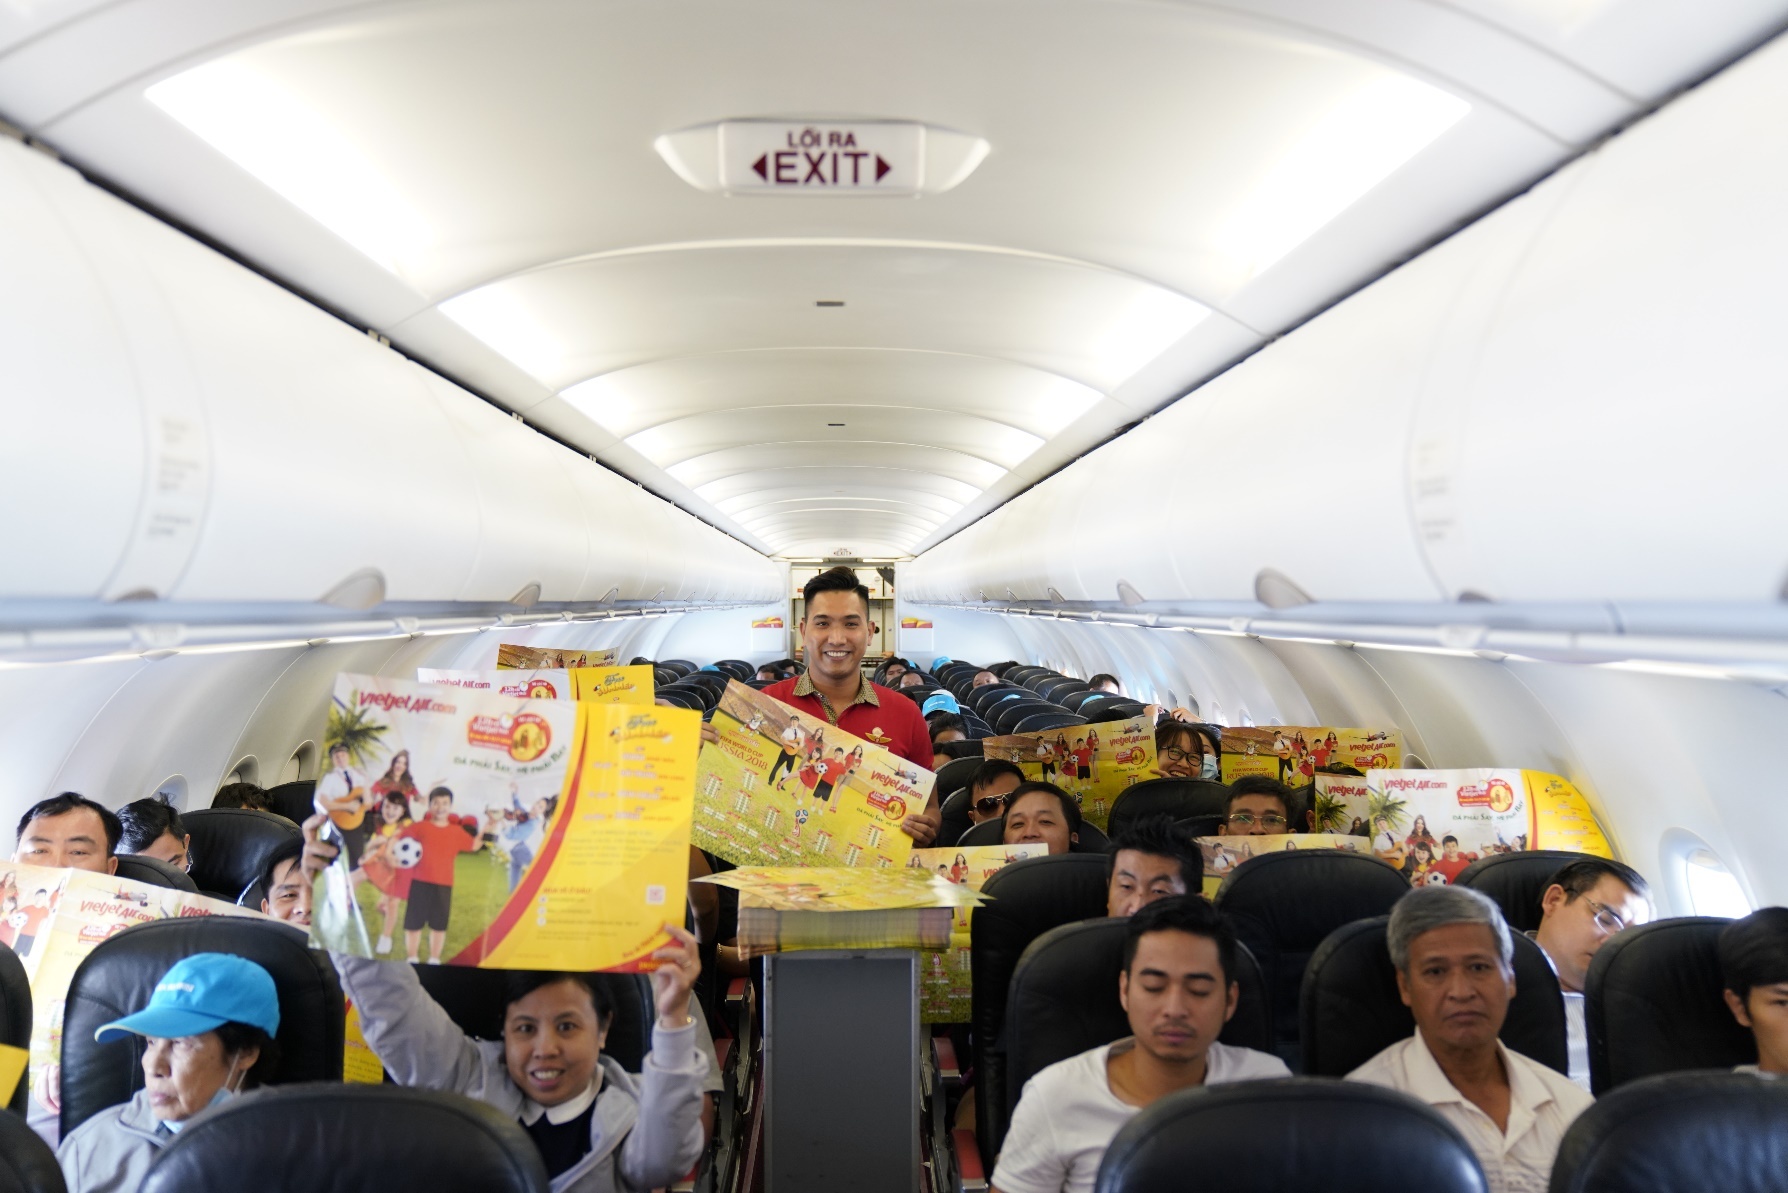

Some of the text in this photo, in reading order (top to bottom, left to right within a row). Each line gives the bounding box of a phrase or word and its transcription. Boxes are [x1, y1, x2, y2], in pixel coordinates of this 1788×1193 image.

[829, 131, 857, 147] RA
[775, 151, 869, 184] EXIT
[720, 735, 731, 745] FIFA
[732, 741, 753, 754] WORLD
[752, 750, 764, 758] CUP
[720, 743, 768, 771] SSIA 2018
